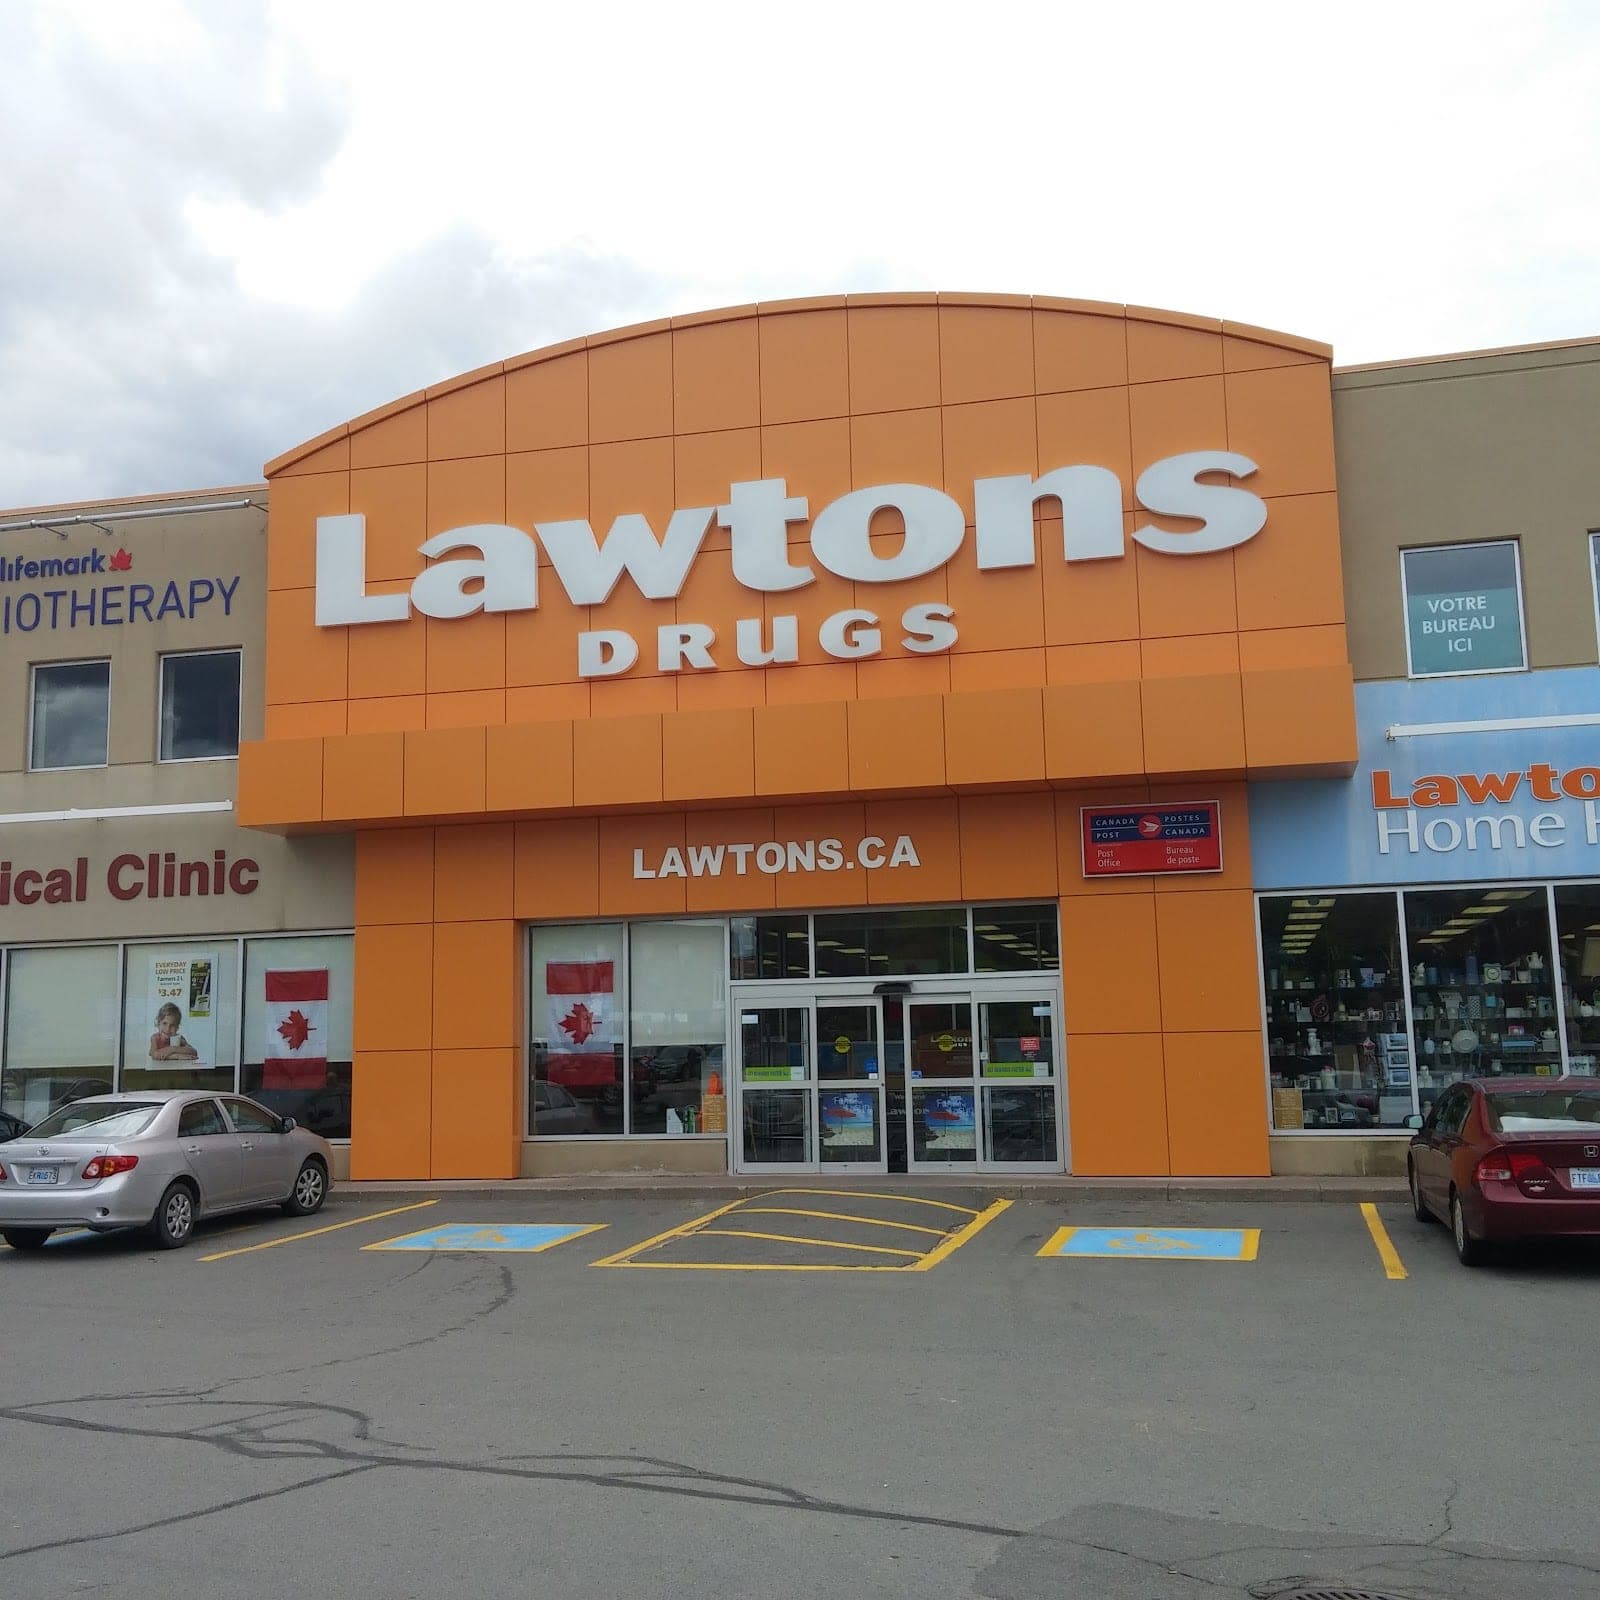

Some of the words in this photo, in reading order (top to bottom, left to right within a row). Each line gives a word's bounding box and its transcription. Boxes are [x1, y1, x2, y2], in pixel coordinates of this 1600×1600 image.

[314, 449, 1268, 628] Lawtons
[0, 548, 105, 581] lifemark
[4, 576, 241, 634] IOTHERAPY
[1427, 596, 1487, 613] VOTRE
[1422, 615, 1495, 634] BUREAU
[577, 602, 958, 678] DRUGS
[1448, 638, 1472, 652] ICI
[1371, 763, 1600, 809] Lawto
[1095, 817, 1137, 827] CANADA
[1164, 814, 1201, 823] POSTES
[1096, 831, 1121, 840] POST
[1164, 827, 1206, 837] CANADA
[1377, 809, 1566, 854] Home
[633, 835, 921, 879] LAWTONS.CA
[1097, 849, 1114, 858] Post
[1166, 846, 1194, 855] Bureau
[1097, 859, 1121, 868] Office
[1167, 856, 1177, 864] de
[1178, 855, 1201, 866] poste
[0, 858, 88, 906] ical
[107, 850, 260, 901] Clinic
